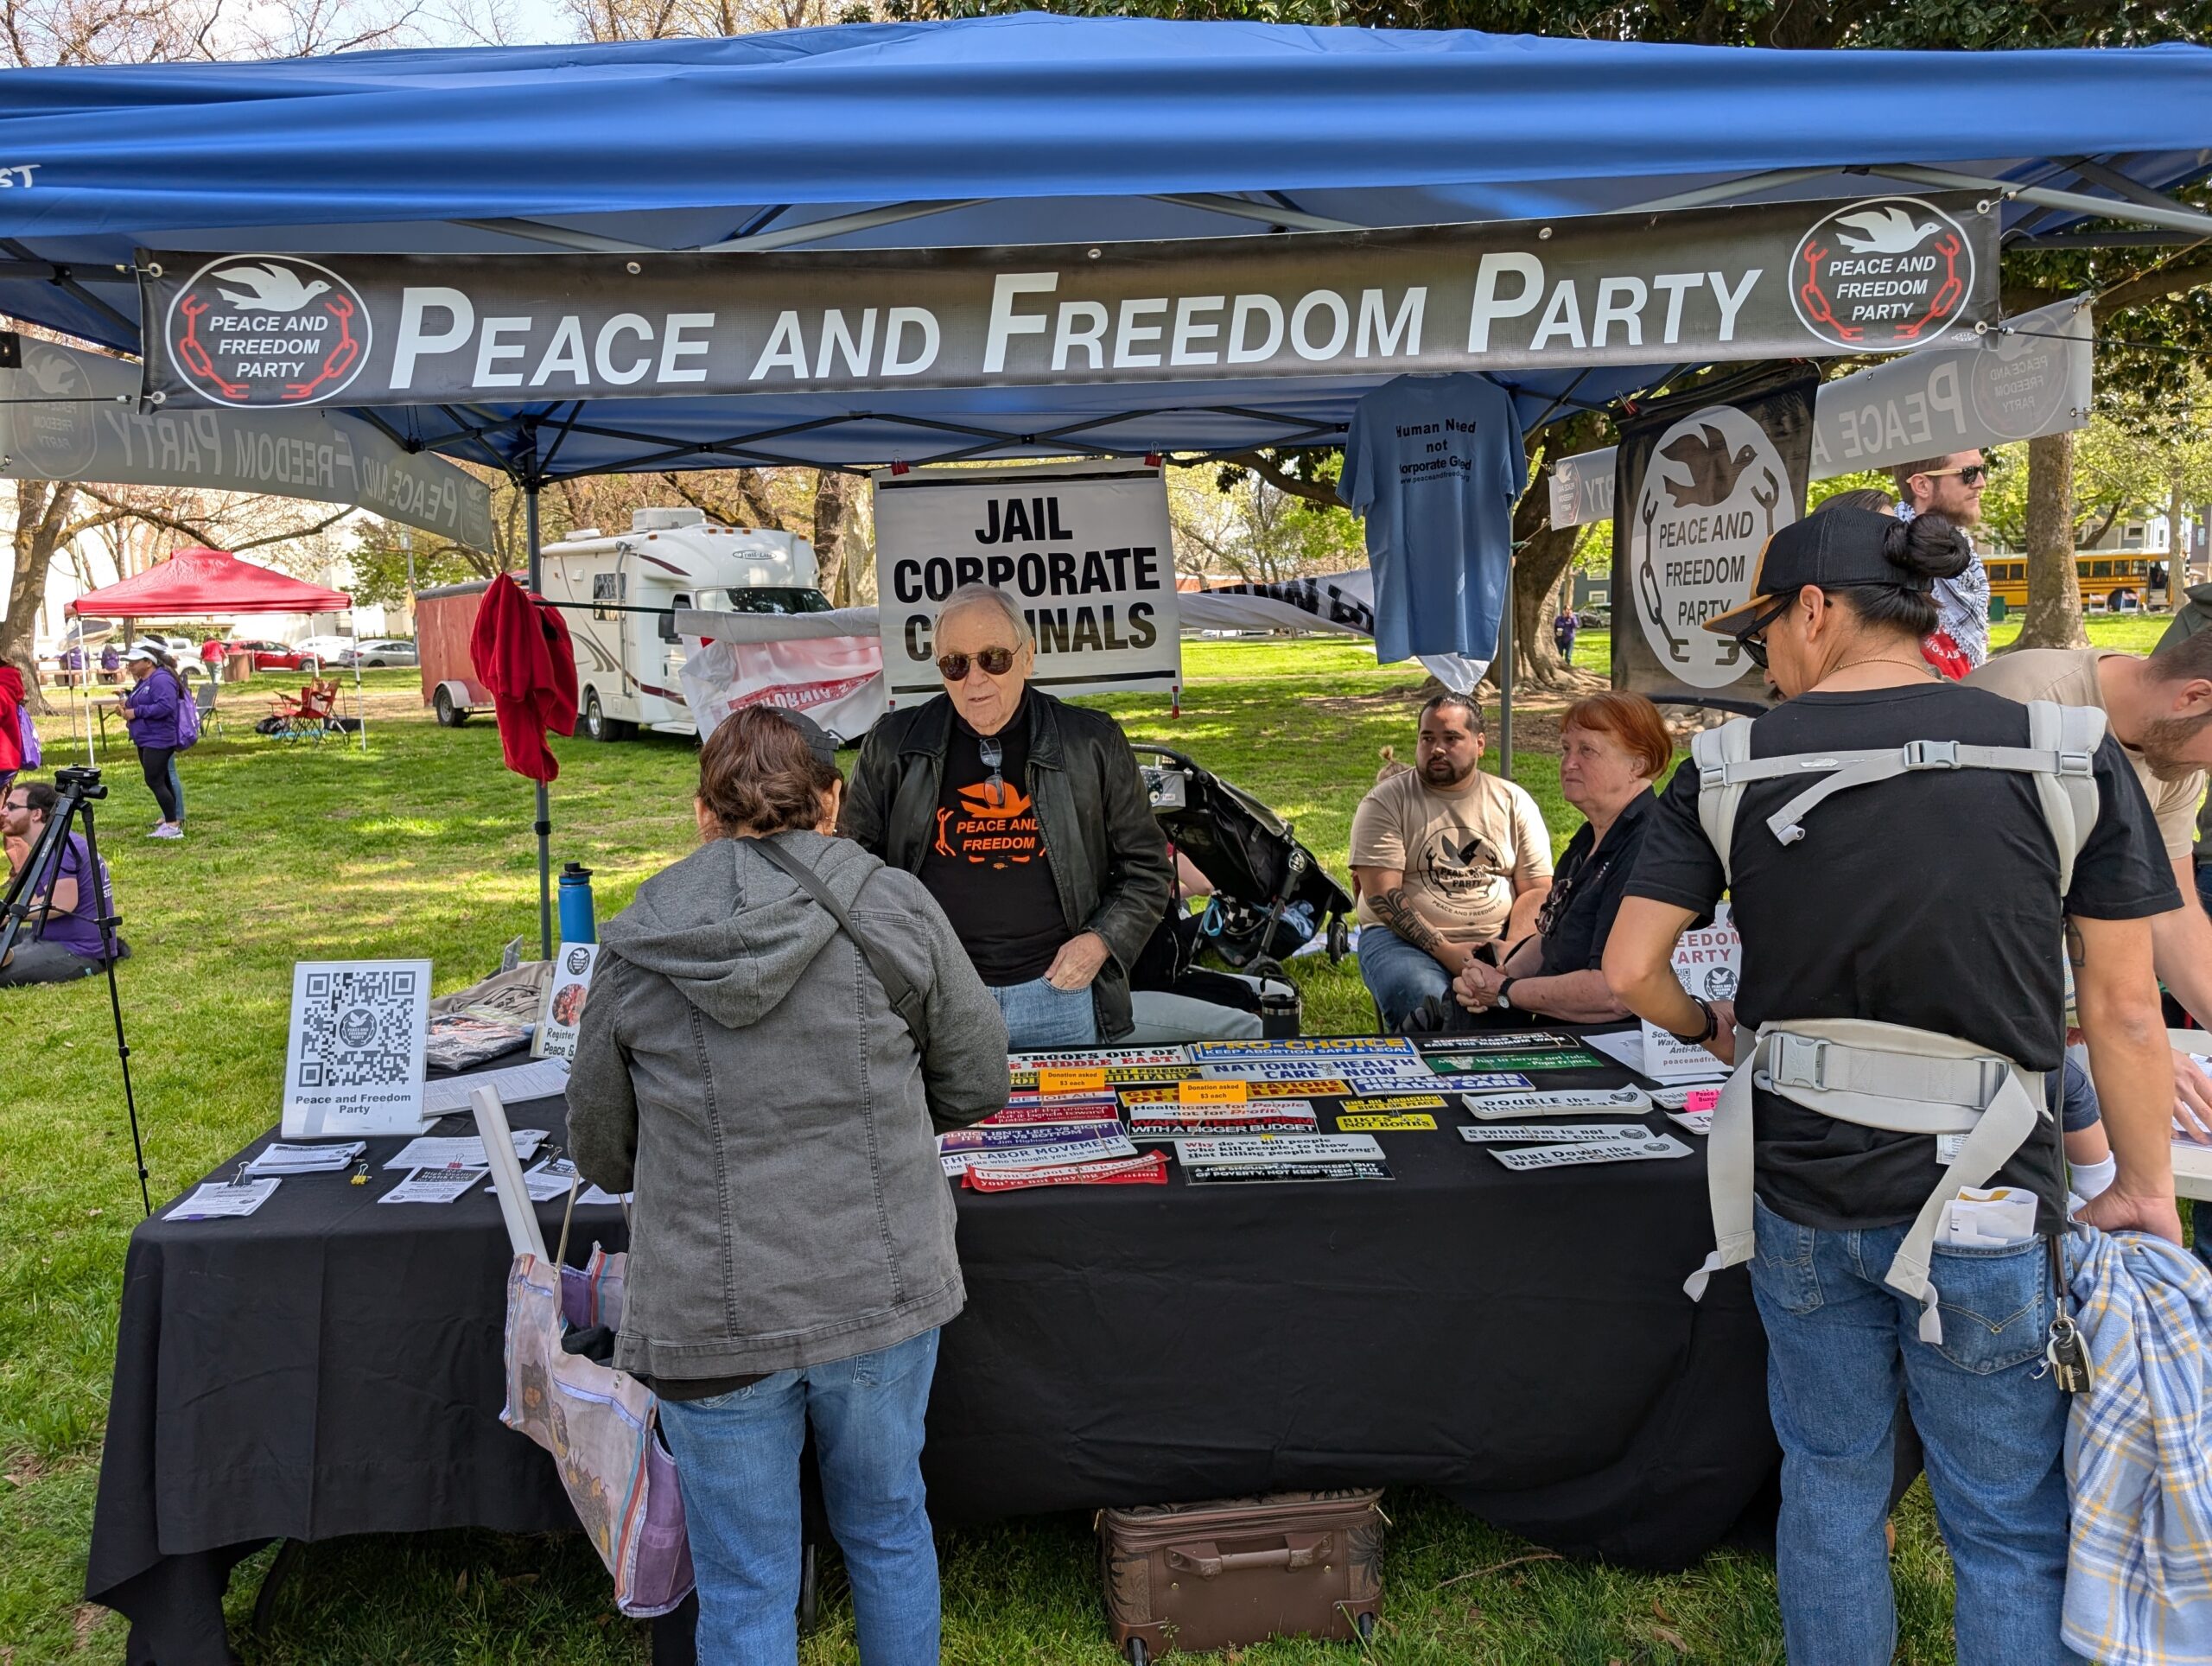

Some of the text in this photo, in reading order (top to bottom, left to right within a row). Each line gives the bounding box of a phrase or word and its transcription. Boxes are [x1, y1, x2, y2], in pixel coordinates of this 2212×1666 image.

[1829, 256, 1936, 277] PEACE AND
[1836, 279, 1929, 299] FREEDOM
[1852, 302, 1914, 321] PARTY
[209, 315, 328, 334] PEACE AND
[389, 251, 1763, 389] PEACE AND FREEDOM PARTY
[218, 339, 320, 356] FREEDOM
[237, 362, 305, 378] PARTY
[1427, 438, 1447, 453] not
[1399, 458, 1446, 474] orporate
[976, 496, 1072, 544] JAIL
[1660, 511, 1754, 549] PEACE AND
[894, 547, 1160, 604] CORPORATE
[1666, 555, 1745, 588] FREEDOM
[905, 602, 1157, 662] CINALS
[957, 820, 1006, 834] PEACE
[963, 836, 1035, 851] FREEDOM
[1670, 949, 1731, 964] ARTY
[547, 1027, 575, 1043] Register
[543, 1042, 575, 1057] Peace &
[1203, 1037, 1407, 1051] PRO-CHOICE
[1018, 1052, 1100, 1061] TROOPS
[1031, 1059, 1113, 1069] MIDDLE
[1122, 1056, 1182, 1065] EAST!
[1213, 1058, 1417, 1072] NATIONAL HEALTH
[1264, 1066, 1397, 1079] CARE NOW
[1462, 1078, 1525, 1088] CARE
[296, 1093, 411, 1105] Peace and Freedom
[339, 1104, 370, 1116] Party
[1134, 1103, 1224, 1112] Healthcare
[1031, 1130, 1084, 1139] BOTTOM
[1250, 1123, 1315, 1132] BUDGET
[941, 1136, 1122, 1166] THE LABOR MOVEMENT
[1505, 1152, 1546, 1160] Shut
[1554, 1148, 1602, 1158] Down
[1012, 1154, 1049, 1165] brought
[1511, 1159, 1555, 1167] WAR
